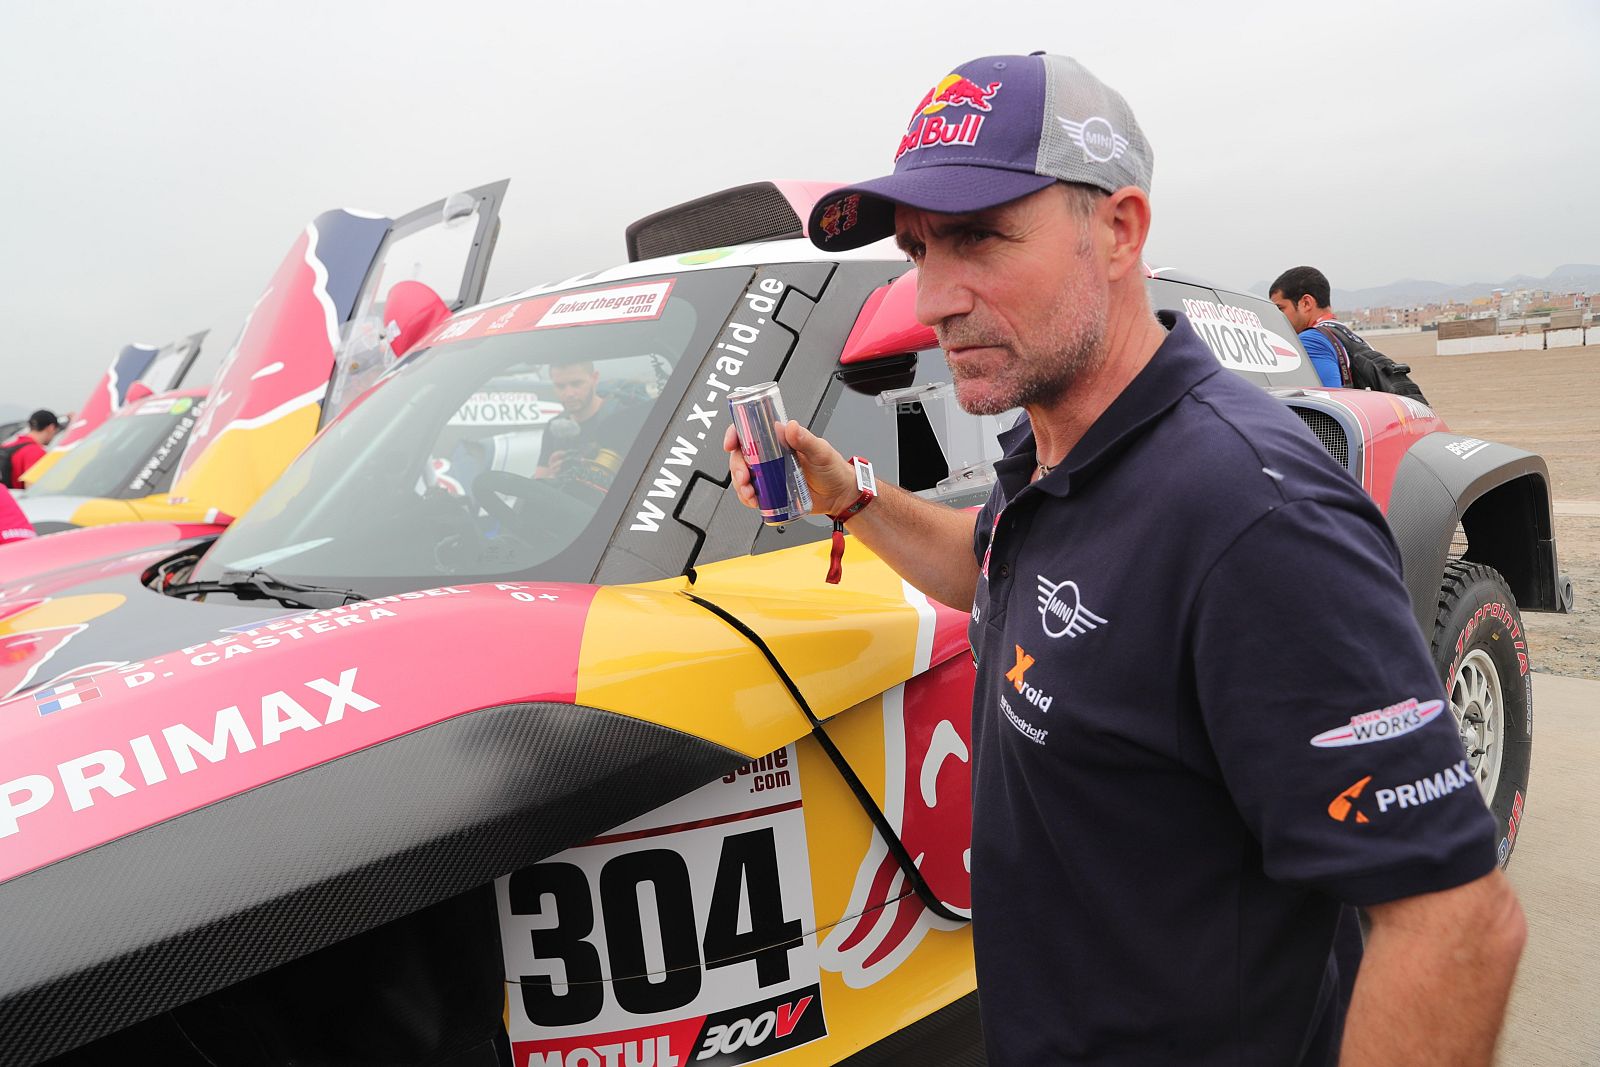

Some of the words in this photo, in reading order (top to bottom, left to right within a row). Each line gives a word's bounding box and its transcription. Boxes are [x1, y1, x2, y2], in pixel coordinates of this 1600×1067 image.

[921, 114, 984, 147] Bull
[1086, 131, 1113, 150] MINI
[552, 293, 658, 315] Dakarthegame
[622, 304, 652, 315] .com
[1184, 299, 1220, 321] JOHN
[1218, 304, 1262, 330] COOPER
[1193, 322, 1278, 367] WORKS
[458, 403, 541, 422] WORKS
[630, 278, 784, 533] www.x-raid.de
[1048, 596, 1074, 624] MINI
[190, 607, 398, 667] CASTERA
[1353, 708, 1421, 740] WORKS
[0, 667, 381, 838] PRIMAX
[750, 770, 791, 793] .com
[1375, 760, 1474, 812] PRIMAX
[508, 826, 804, 1028] 304
[696, 995, 813, 1061] 300V
